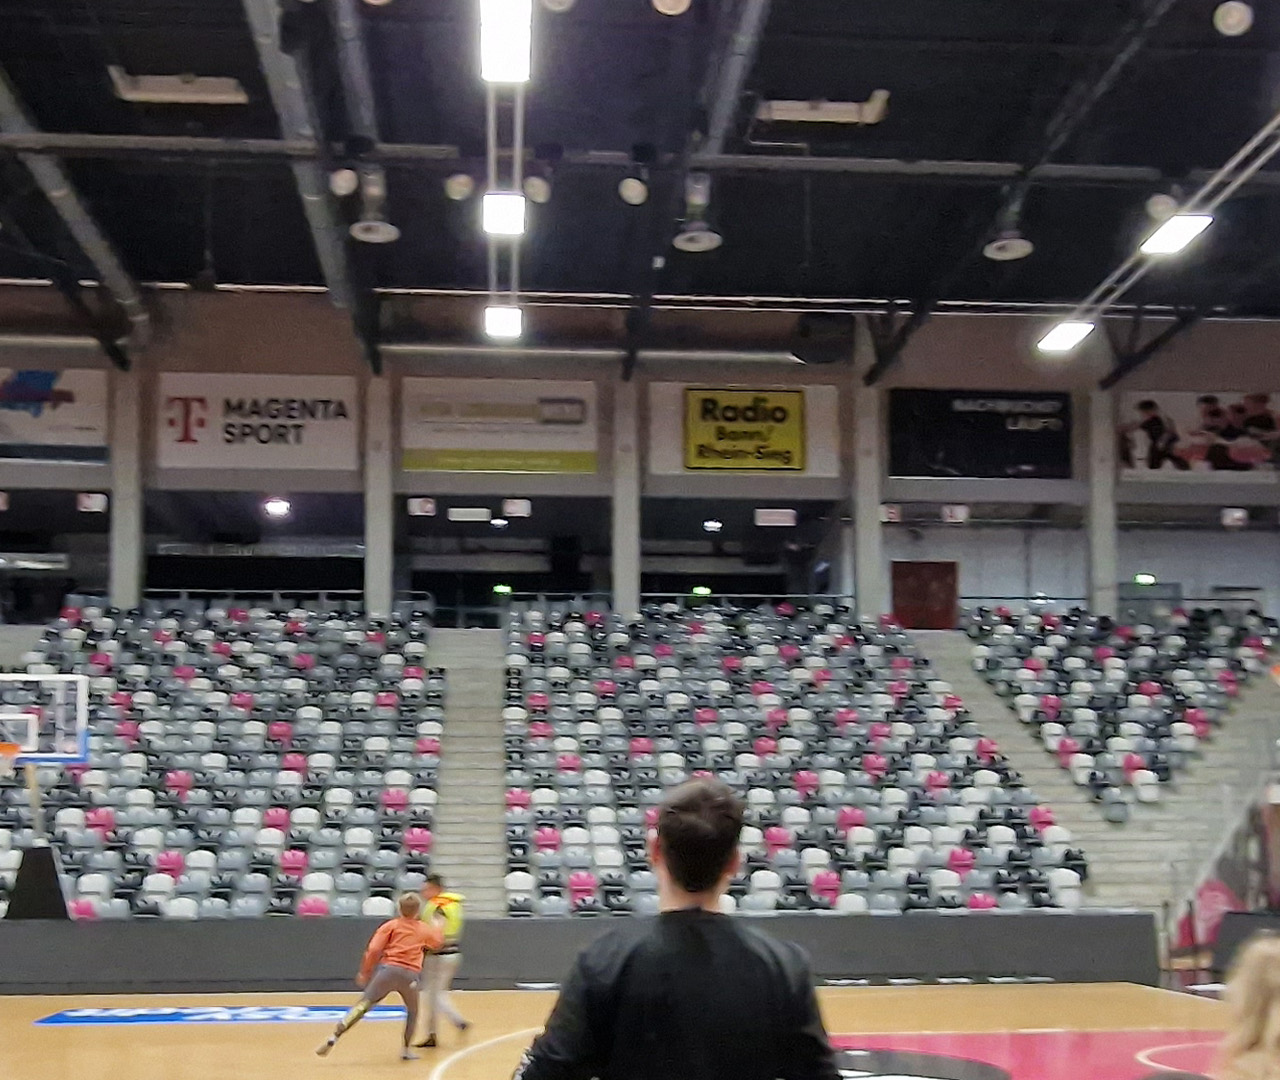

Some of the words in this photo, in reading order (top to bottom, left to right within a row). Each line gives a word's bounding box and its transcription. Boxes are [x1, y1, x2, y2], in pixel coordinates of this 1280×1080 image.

[223, 398, 348, 419] MAGENTA
[700, 396, 787, 422] Radio
[223, 422, 304, 444] SPORT
